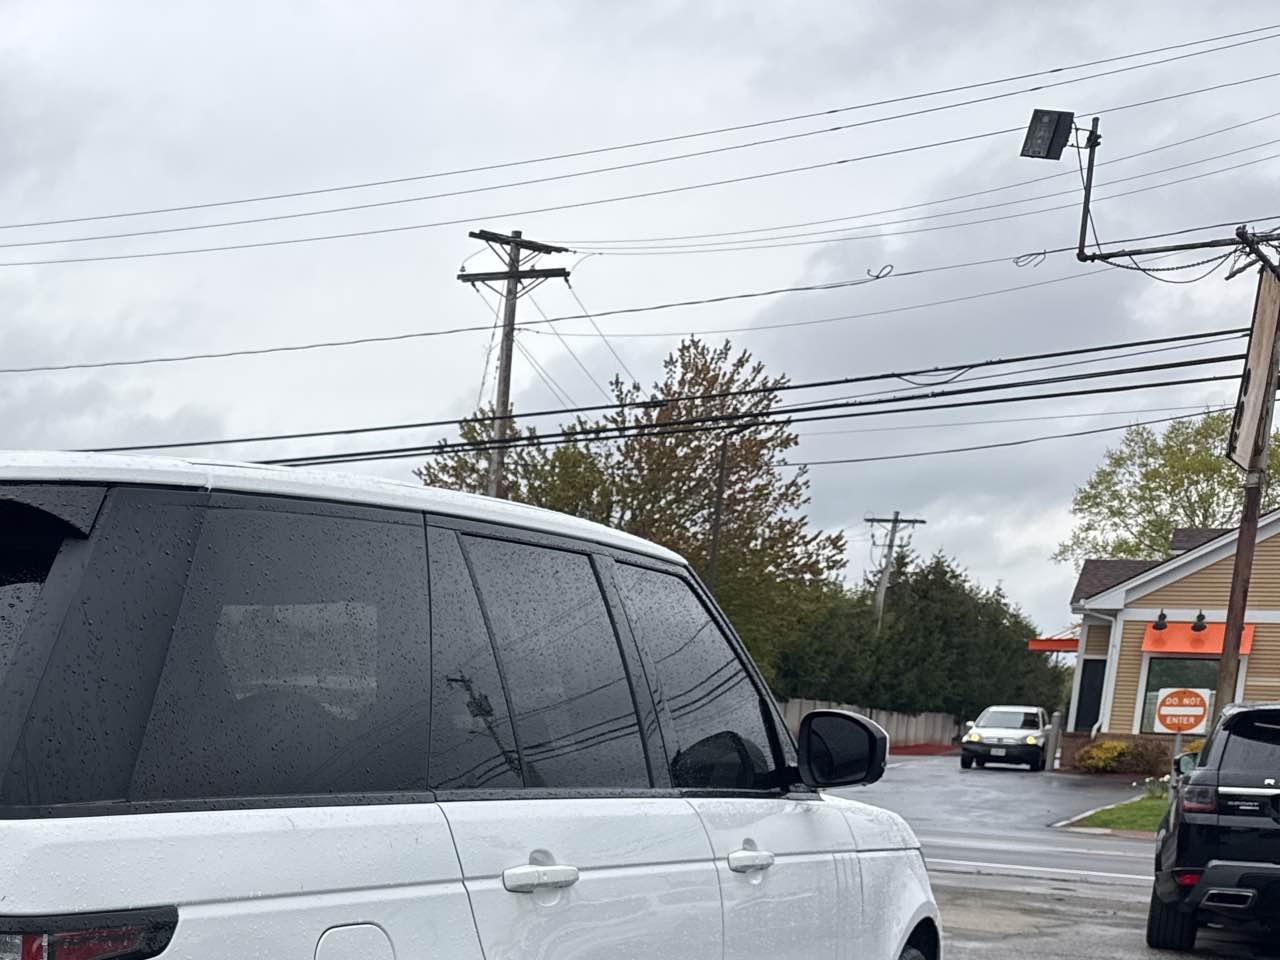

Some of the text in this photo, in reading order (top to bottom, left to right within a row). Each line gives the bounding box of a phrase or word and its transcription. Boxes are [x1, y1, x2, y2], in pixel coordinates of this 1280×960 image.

[1165, 696, 1201, 706] DO NOT
[1166, 716, 1195, 725] ENTER
